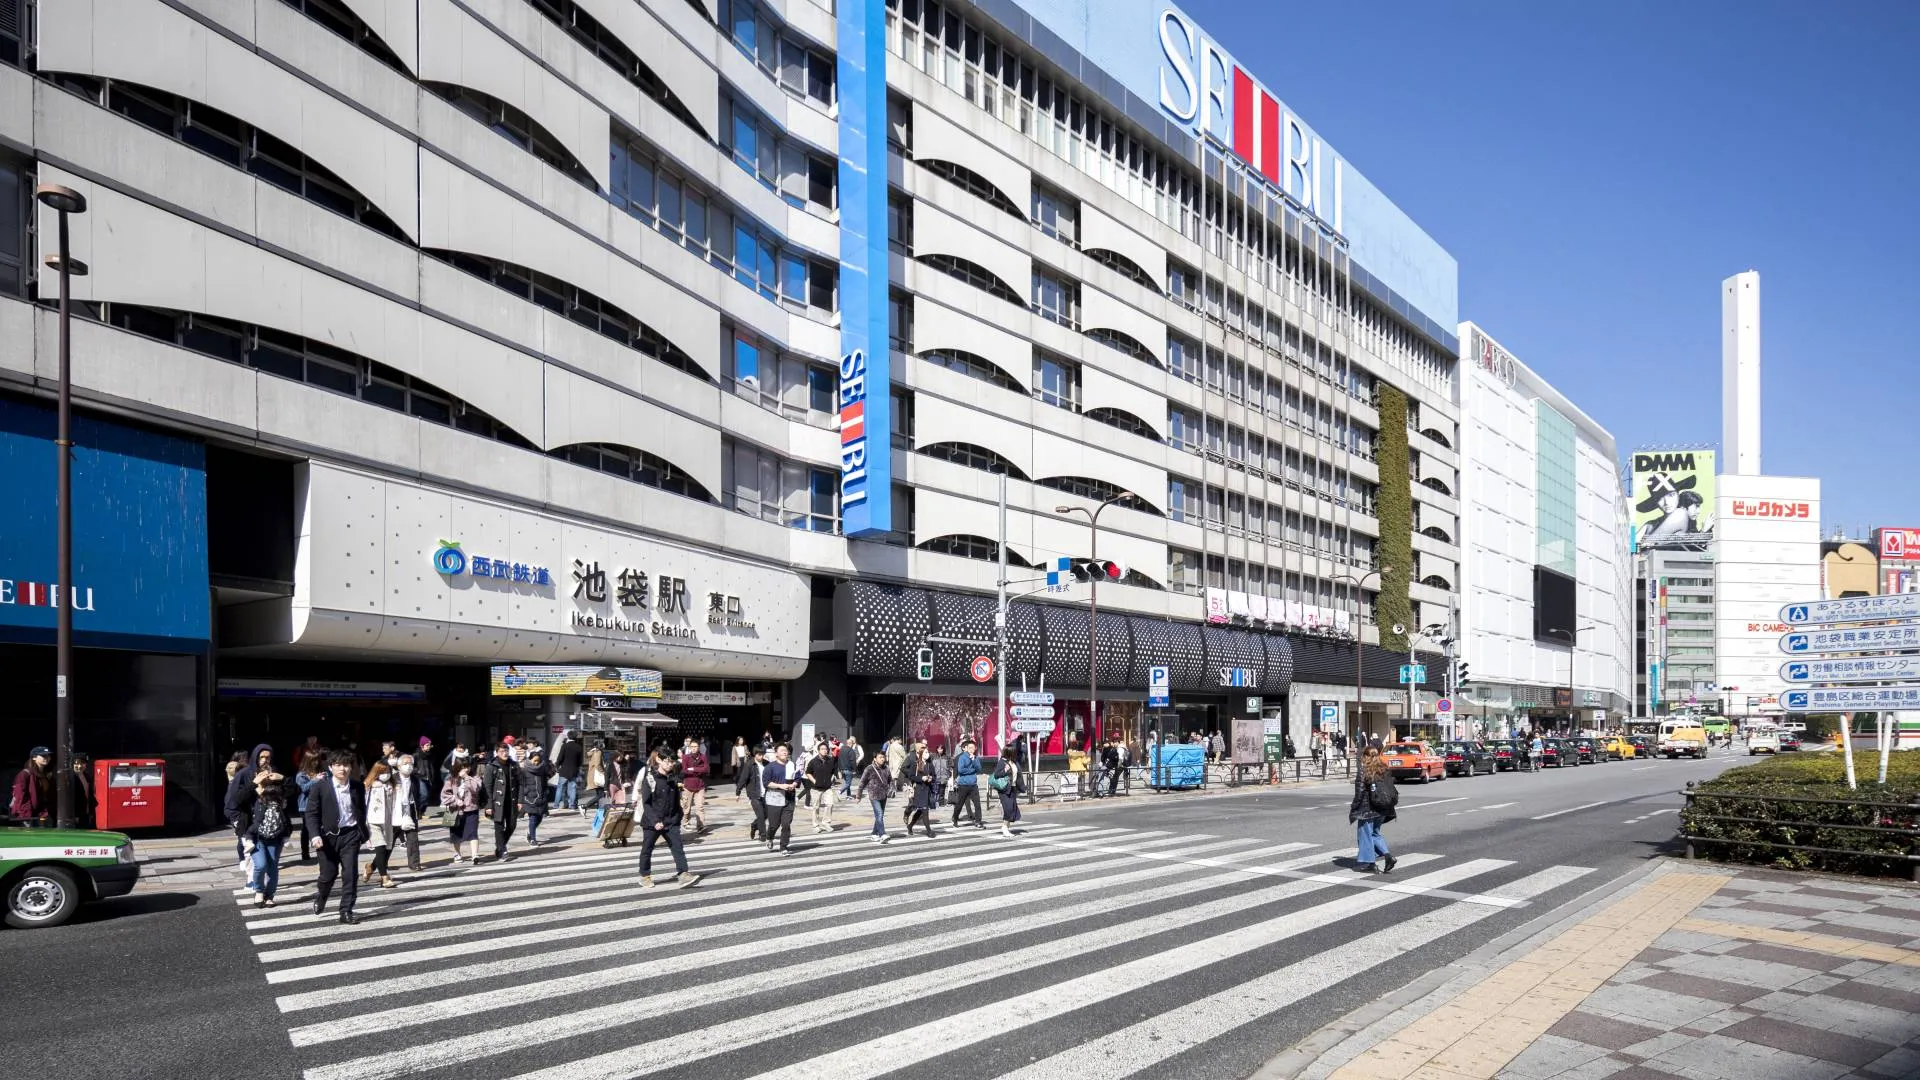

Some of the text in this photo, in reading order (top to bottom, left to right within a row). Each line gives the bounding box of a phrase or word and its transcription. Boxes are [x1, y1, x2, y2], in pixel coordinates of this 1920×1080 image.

[1159, 9, 1342, 238] SEIBU
[1477, 335, 1516, 388] PARCO
[841, 349, 867, 508] SEIBU
[1635, 454, 1696, 472] DMM
[1733, 501, 1809, 518] ビックカメラ
[472, 555, 549, 586] 西武鉄道
[573, 558, 740, 615] 池袋駅 東口
[571, 611, 645, 634] Ikebukuro
[651, 621, 697, 640] Station
[1748, 624, 1760, 632] BIC
[1815, 628, 1918, 643] 池袋職業安定所
[1813, 659, 1919, 673] 労働相談情報センター
[1153, 669, 1164, 684] P
[1220, 667, 1257, 688] SEIBU
[1814, 690, 1918, 701] 豊島区総合運動場
[1322, 707, 1335, 721] P
